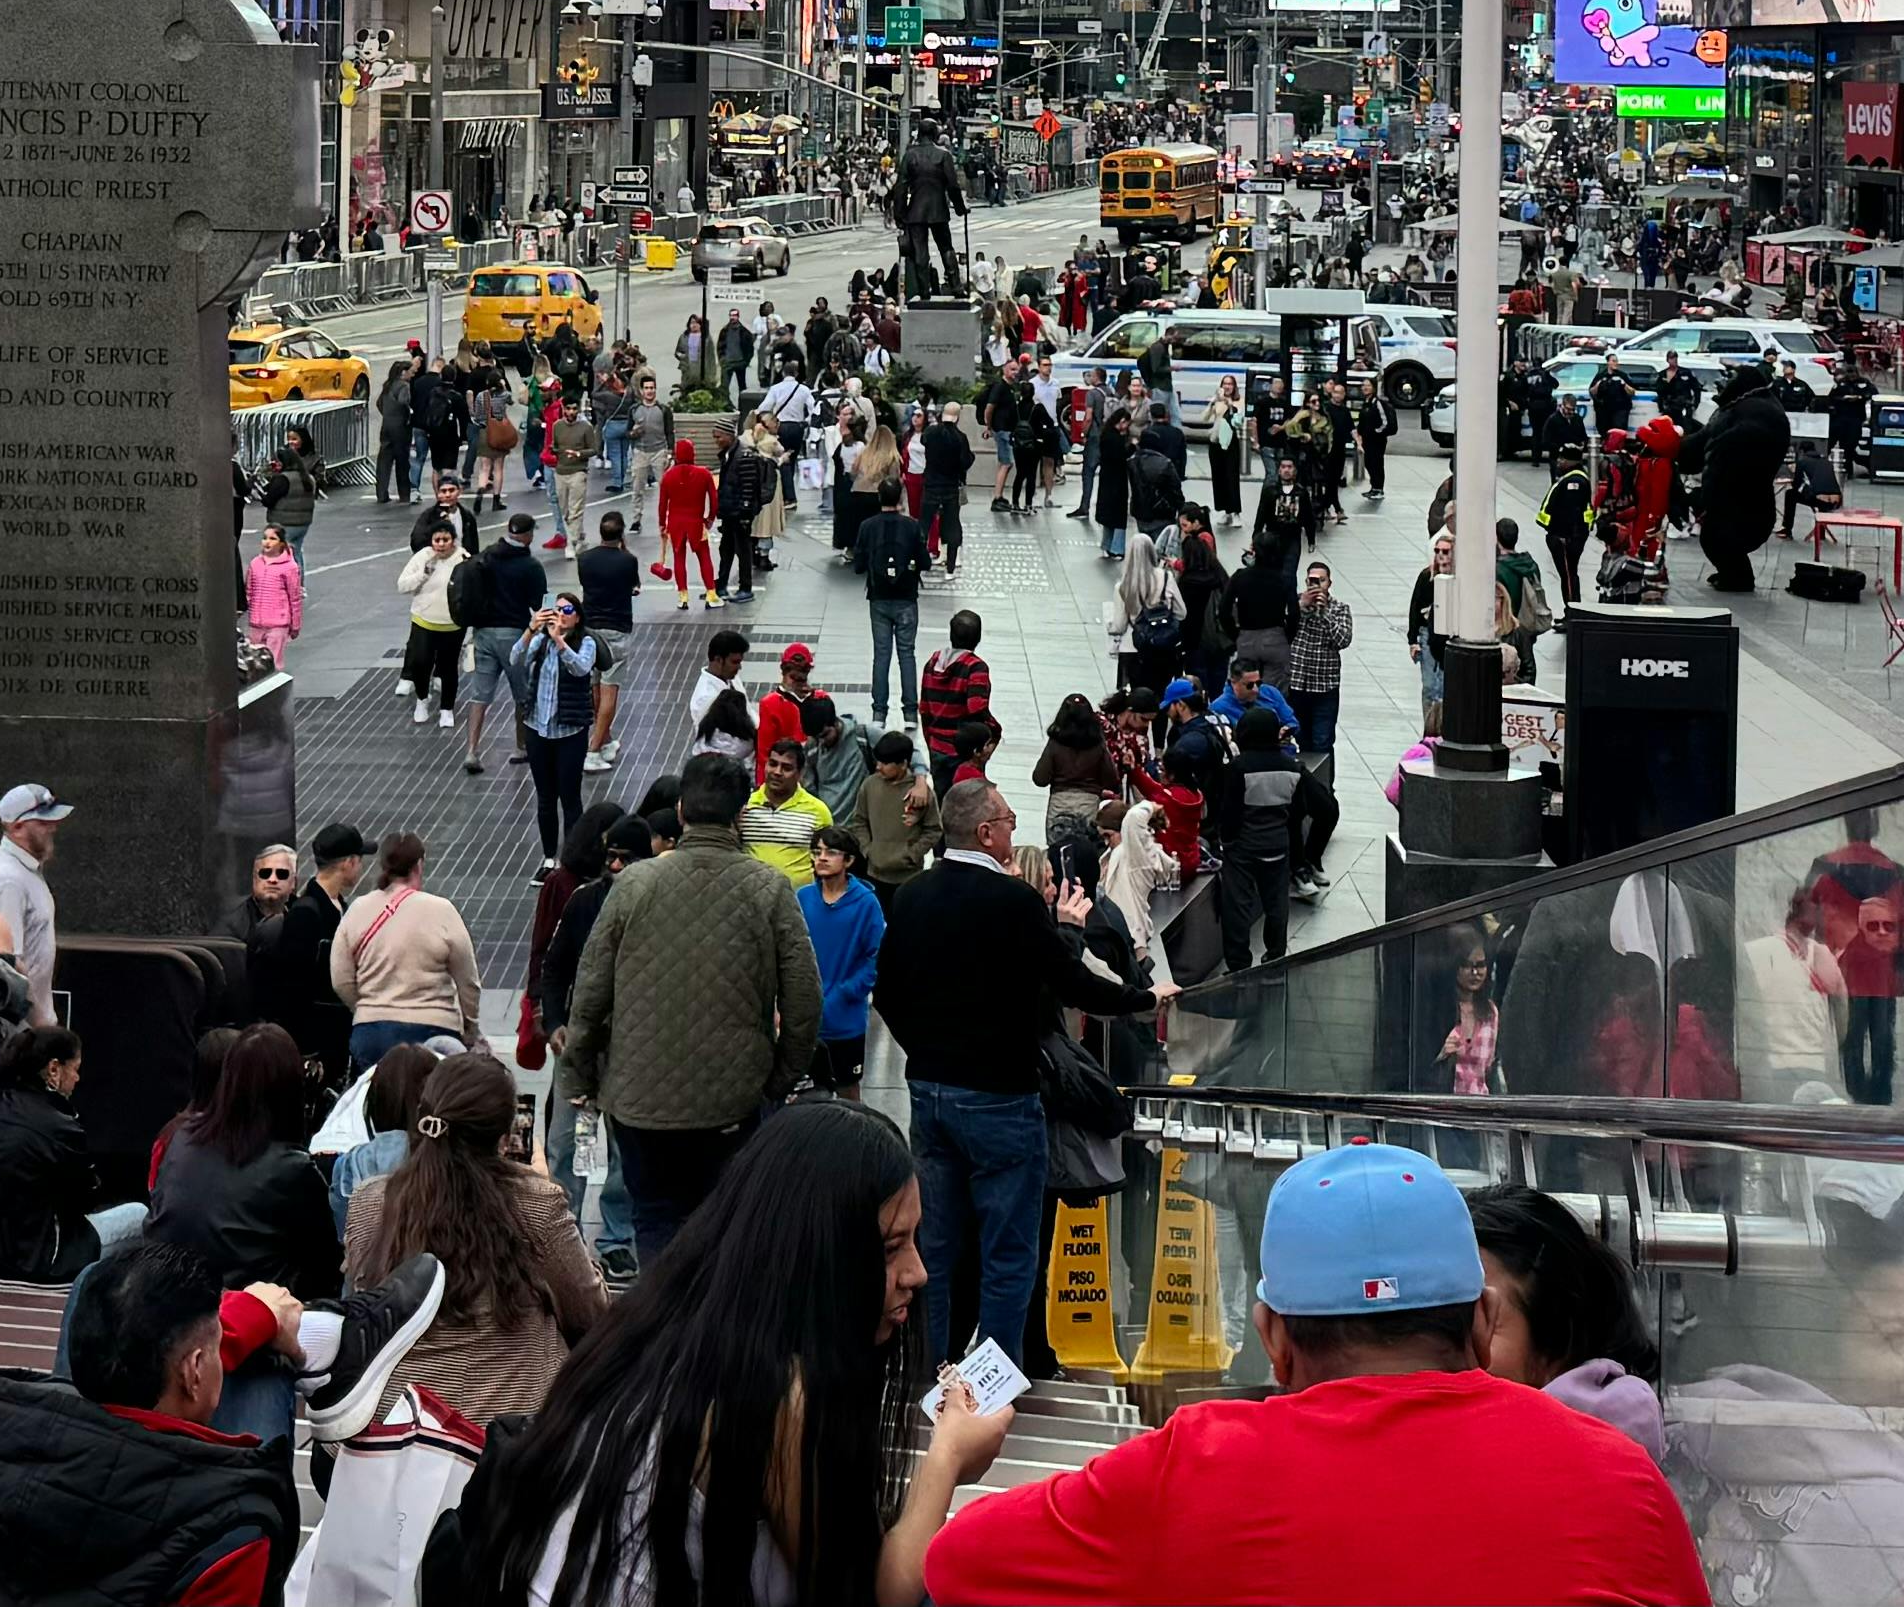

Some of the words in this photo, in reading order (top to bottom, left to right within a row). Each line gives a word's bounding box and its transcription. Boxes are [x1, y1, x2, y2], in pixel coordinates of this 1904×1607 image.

[90, 83, 190, 103] COLONEL
[107, 110, 211, 138] DUFFY
[150, 146, 191, 163] 1932
[96, 180, 173, 199] PRIEST
[22, 232, 123, 251] CHAPLAIN
[0, 290, 41, 307] OLD
[49, 347, 75, 365] OF
[83, 347, 170, 366] SERVICE
[51, 369, 85, 384] FOR
[19, 388, 66, 406] AND
[74, 389, 173, 409] COUNTRY
[36, 469, 127, 487] NATIONAL
[65, 574, 136, 592] SERVICE
[143, 575, 199, 593] CROSS
[64, 600, 134, 618] SERVICE
[140, 601, 202, 619] MEDAL
[62, 626, 133, 644] SERVICE
[141, 627, 197, 645] CROSS
[1621, 658, 1688, 679] HOPE
[1070, 1225, 1095, 1238] WET
[1063, 1242, 1101, 1256] FLOOR
[1069, 1271, 1094, 1285] PISO
[1058, 1289, 1106, 1302] MOJADO
